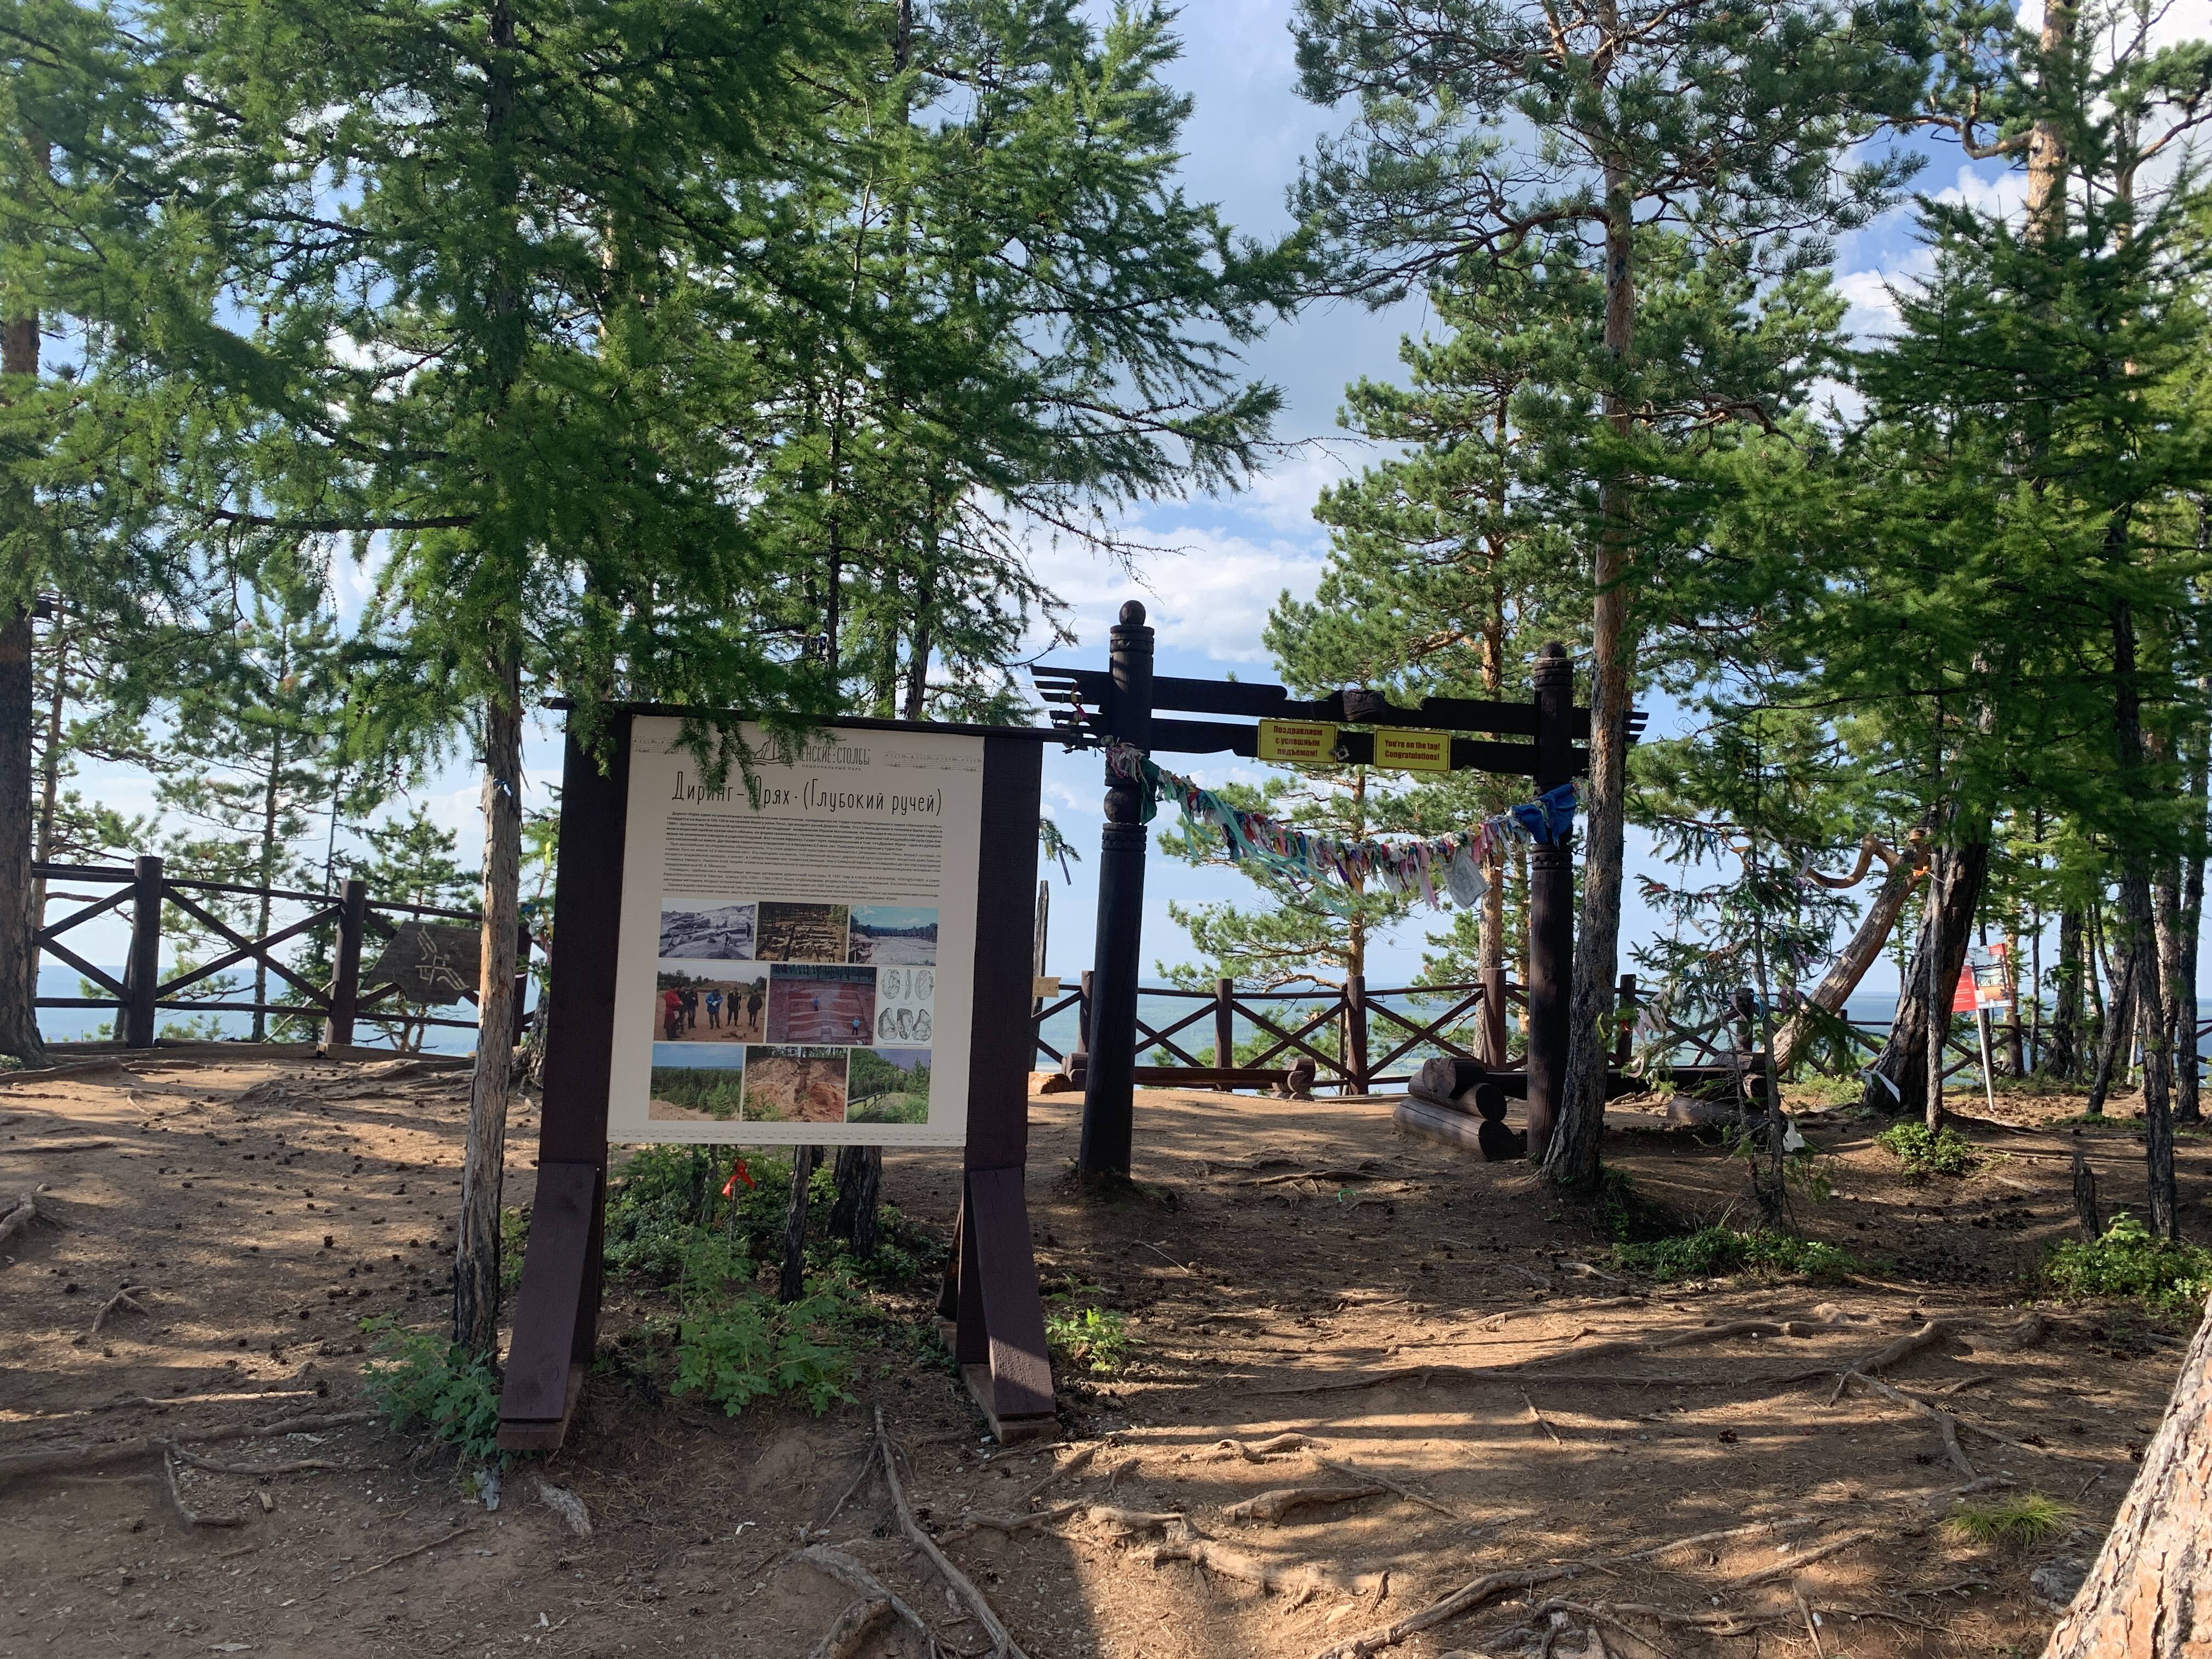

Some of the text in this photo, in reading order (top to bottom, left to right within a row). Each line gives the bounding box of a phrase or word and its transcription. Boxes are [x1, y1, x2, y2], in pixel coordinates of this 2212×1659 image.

[1273, 725, 1323, 736] Поздравляем
[1281, 737, 1321, 747] успешным
[1385, 739, 1405, 747] You're
[1415, 741, 1426, 749] the
[1427, 742, 1440, 751] top!
[837, 747, 871, 765] СТОЛБЫ
[1277, 748, 1318, 757] подъемом!
[1385, 749, 1440, 761] Congratulations!
[804, 779, 884, 812] (Глубокий
[892, 788, 941, 816] ручей)
